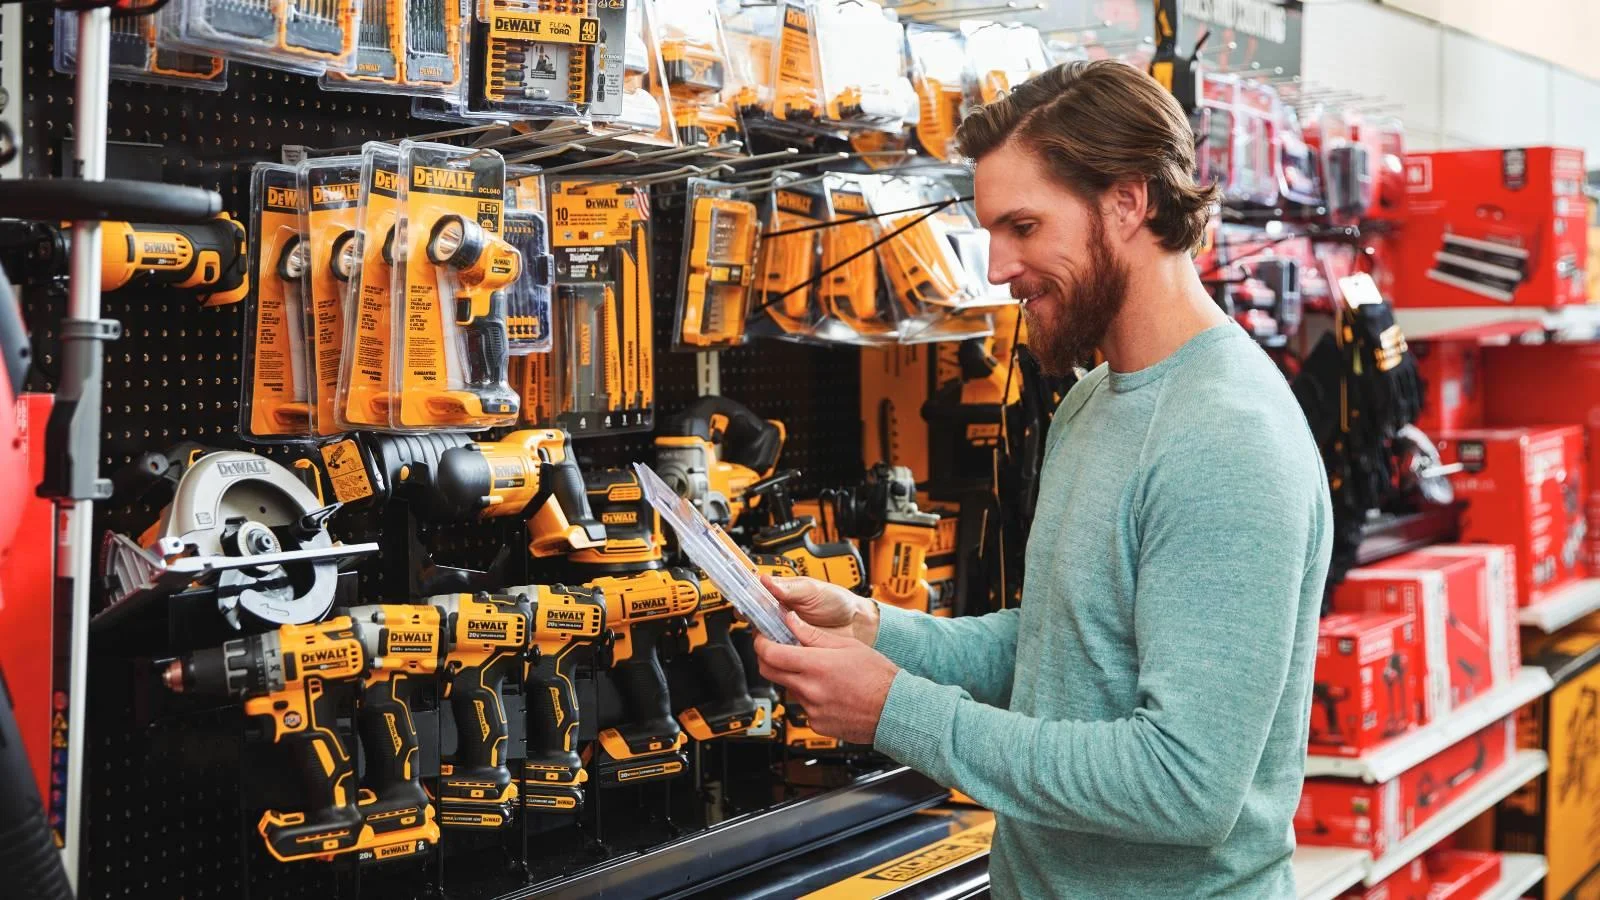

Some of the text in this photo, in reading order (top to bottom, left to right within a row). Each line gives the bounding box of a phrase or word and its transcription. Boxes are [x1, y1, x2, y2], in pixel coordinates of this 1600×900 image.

[495, 18, 540, 33] DEWALT
[582, 22, 596, 34] 40
[414, 167, 475, 191] DEWALT
[479, 202, 498, 214] LED
[556, 207, 568, 221] 10
[602, 511, 637, 523] DEWALT
[632, 597, 667, 611] DEWALT
[547, 609, 586, 621] DEWALT
[468, 620, 508, 631] DEWALT
[390, 632, 433, 643] DEWALT
[301, 649, 348, 664] DEWALT
[381, 844, 410, 856] DEWALT
